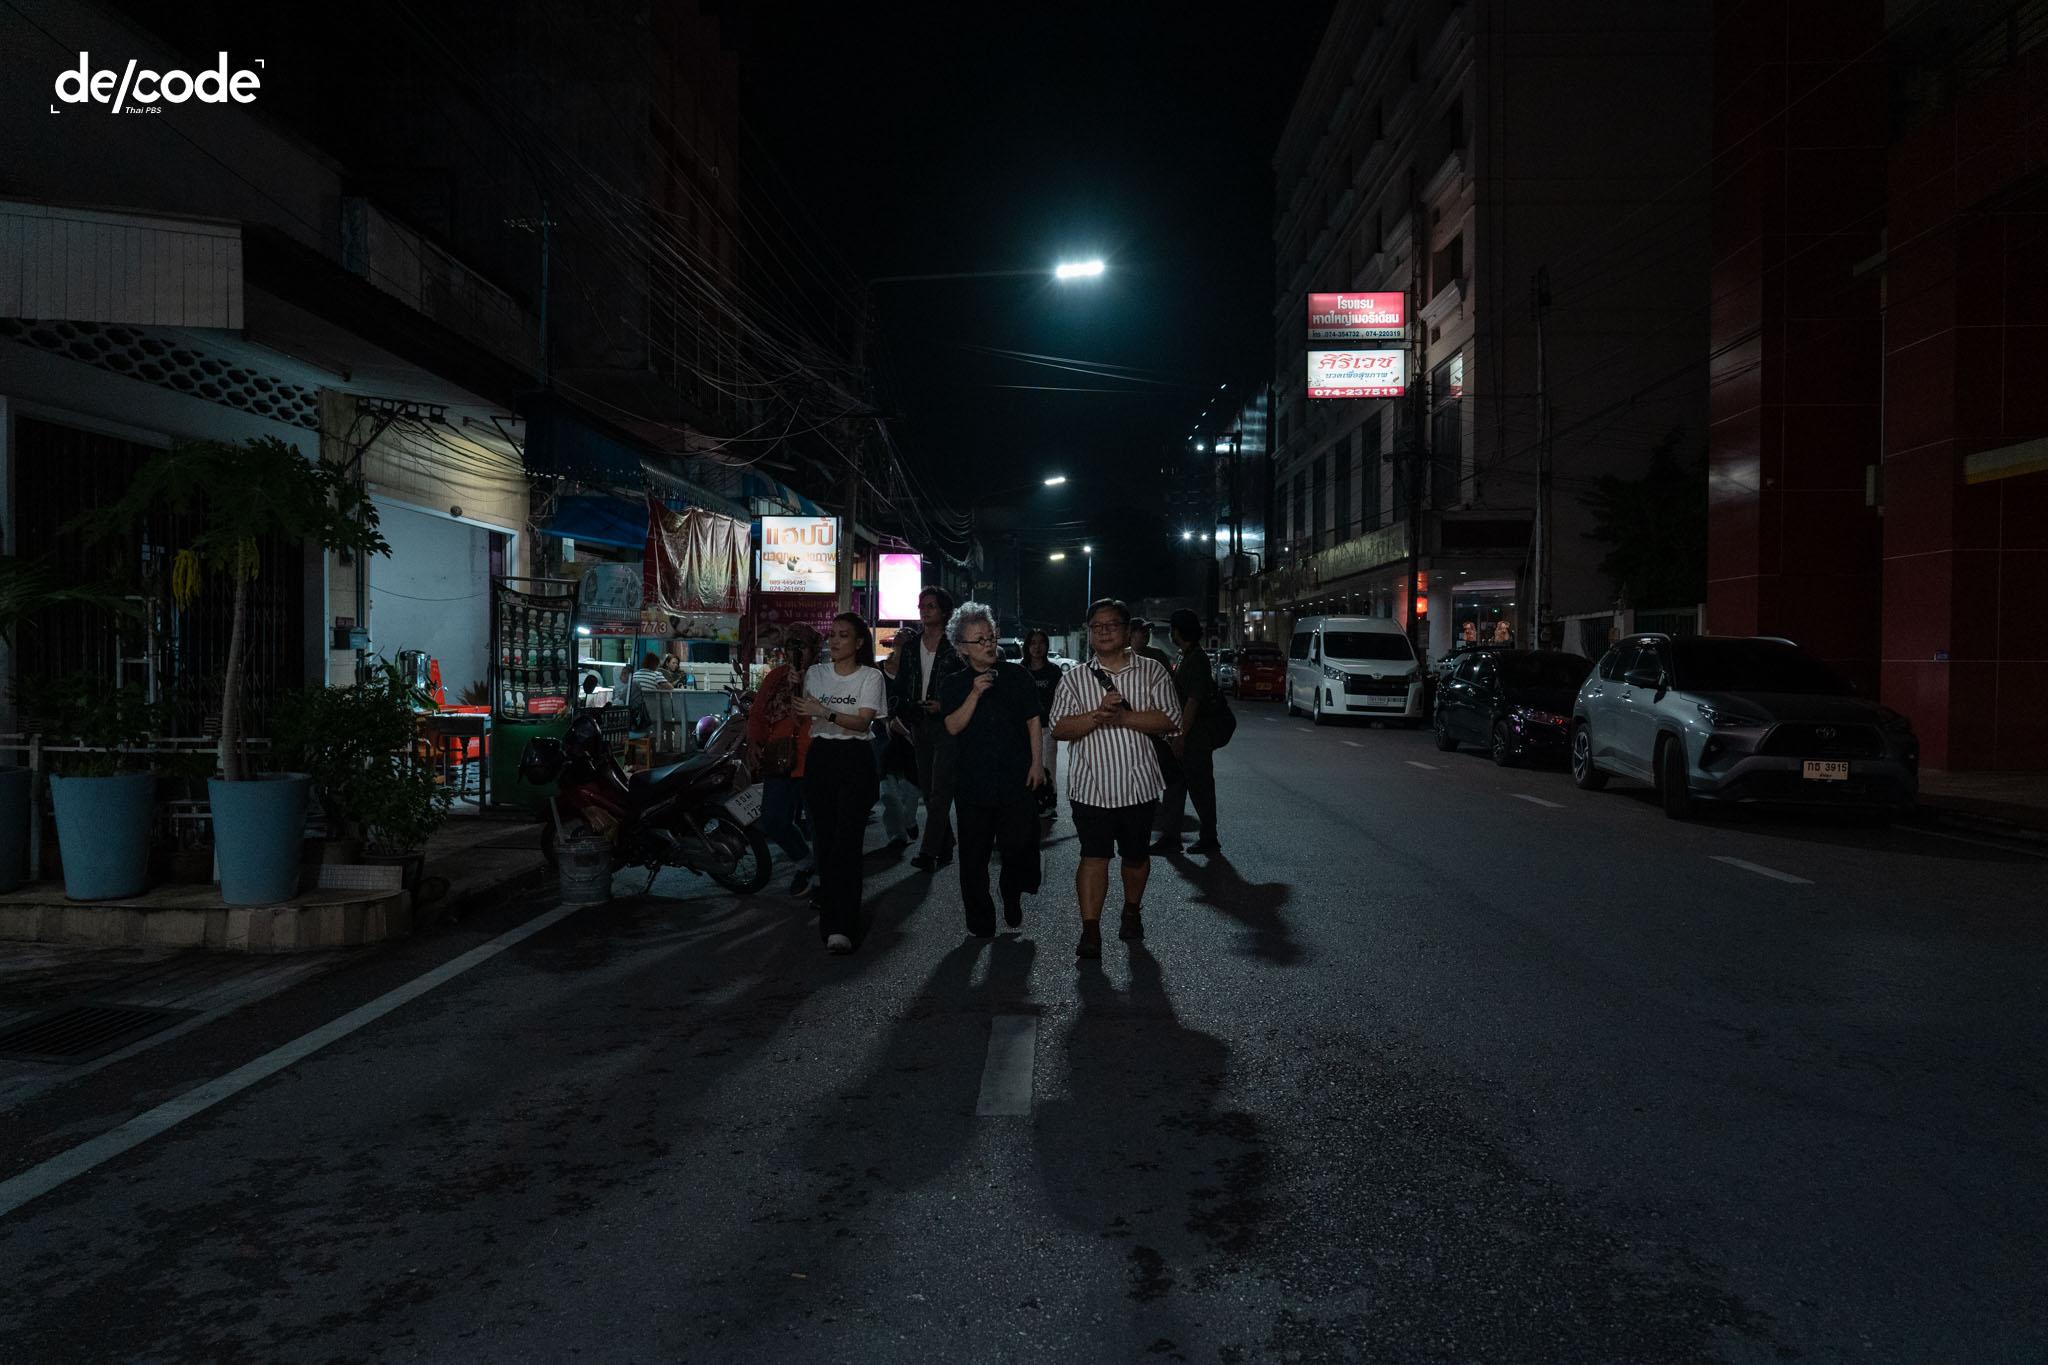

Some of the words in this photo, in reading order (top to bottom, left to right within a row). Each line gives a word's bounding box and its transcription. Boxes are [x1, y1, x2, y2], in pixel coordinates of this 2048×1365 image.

[1337, 295, 1374, 310] โรงแรม
[1318, 352, 1397, 369] ศิริเวช
[1314, 388, 1399, 396] 074-237519
